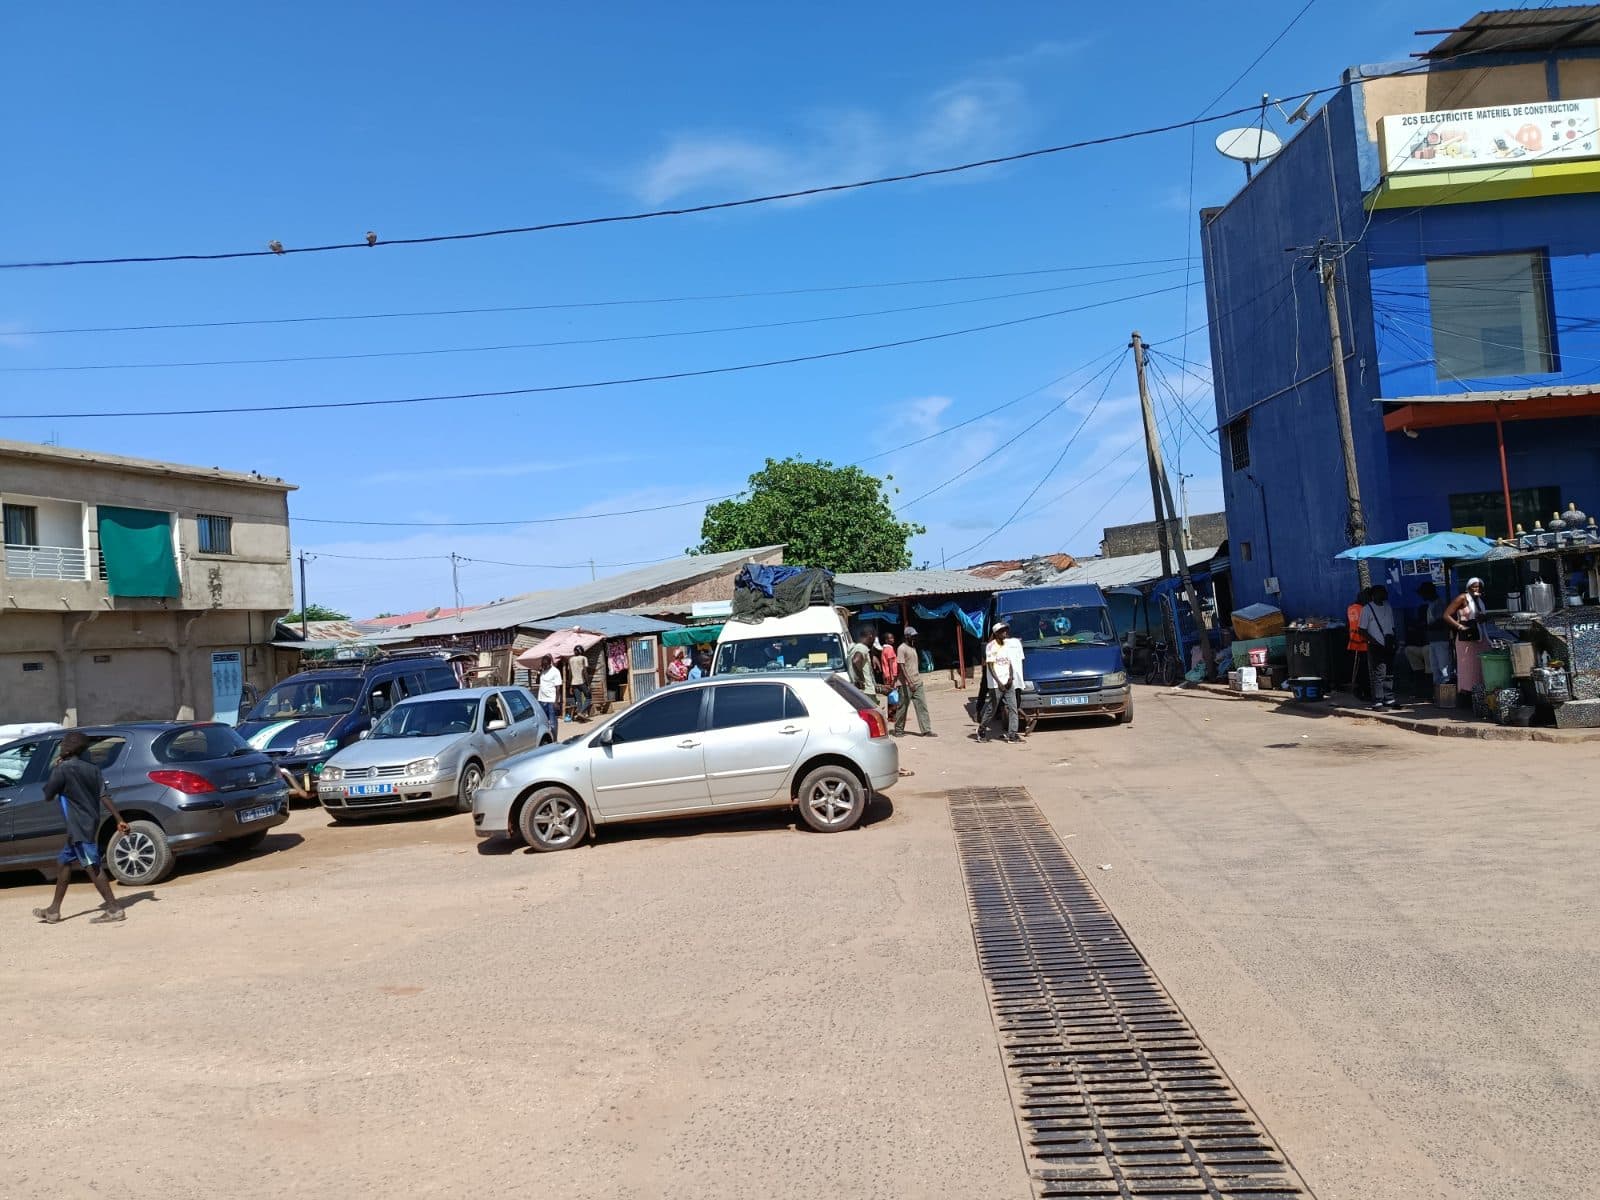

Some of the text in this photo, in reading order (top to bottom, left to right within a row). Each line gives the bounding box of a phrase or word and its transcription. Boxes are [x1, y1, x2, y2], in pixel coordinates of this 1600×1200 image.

[1402, 103, 1580, 126] 2CS ELECTRICITE MATERIEL DE CONSTRUCTION
